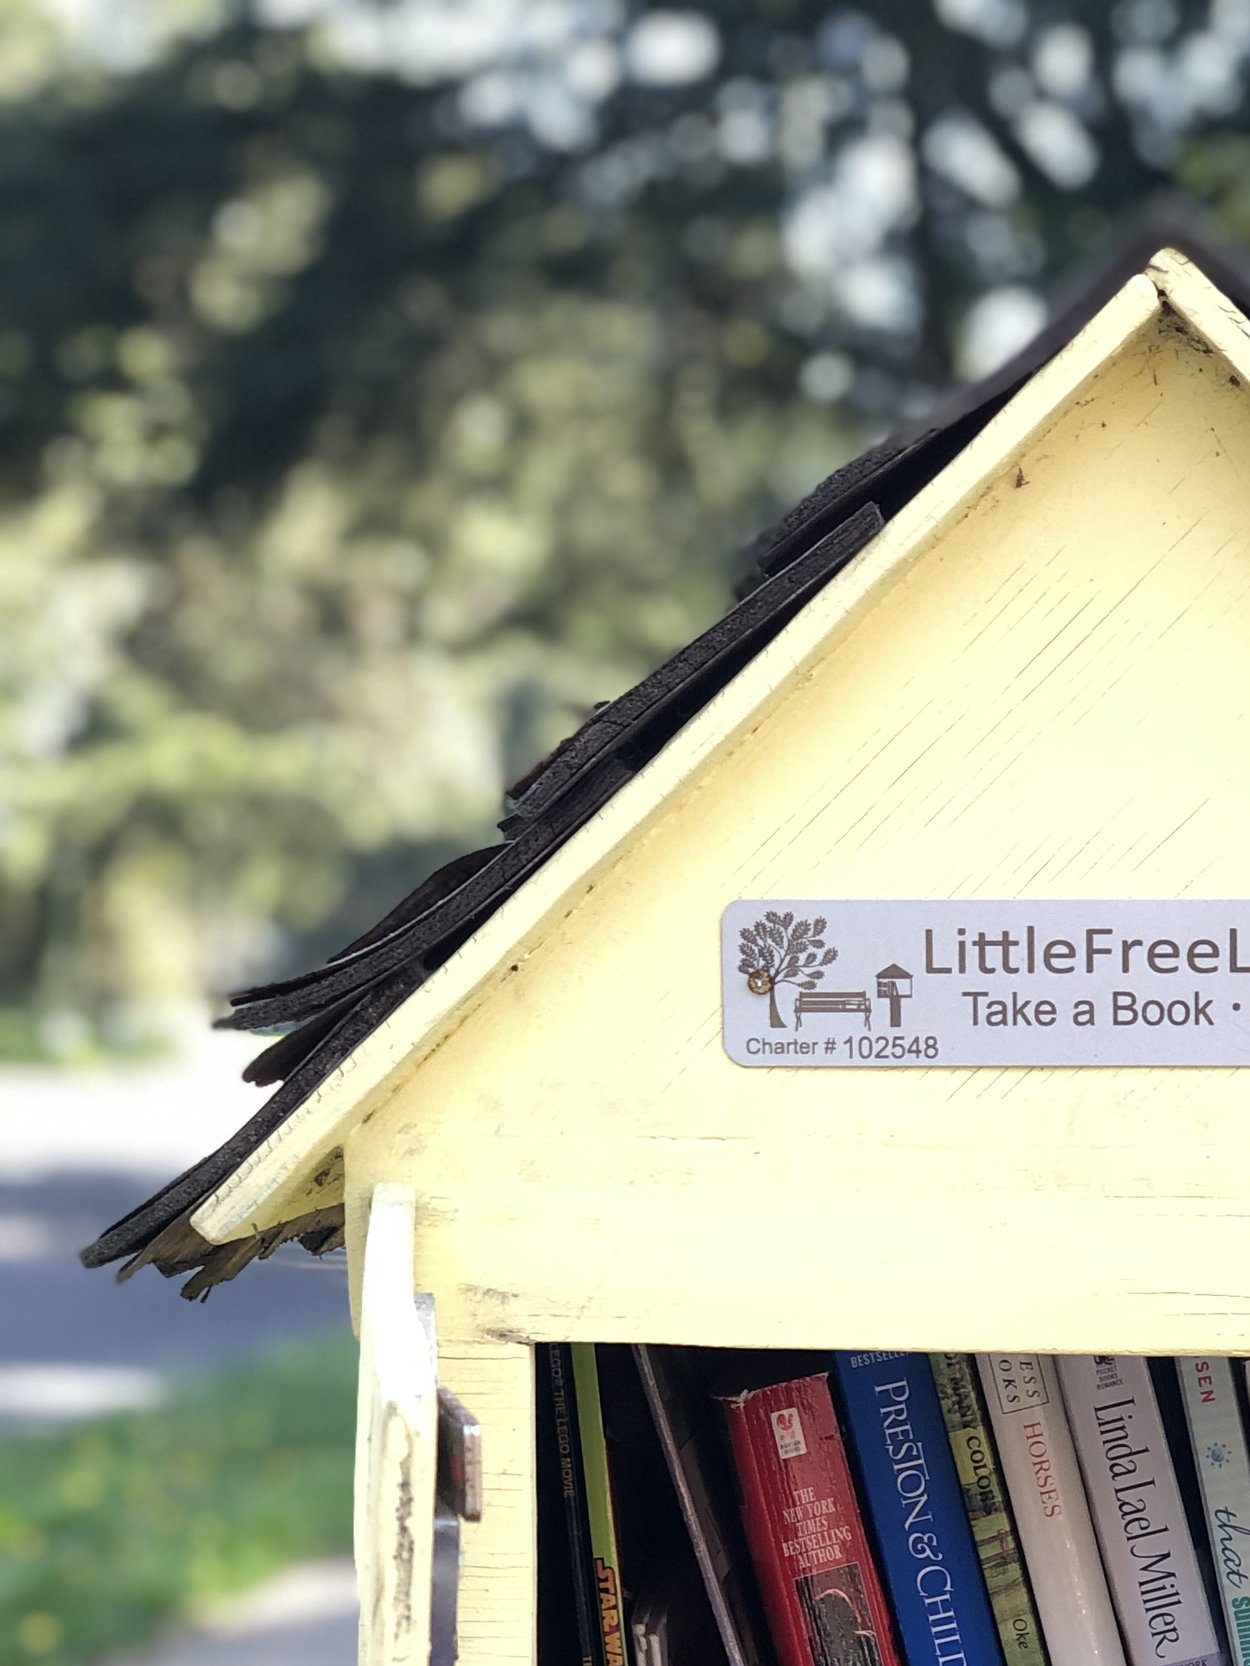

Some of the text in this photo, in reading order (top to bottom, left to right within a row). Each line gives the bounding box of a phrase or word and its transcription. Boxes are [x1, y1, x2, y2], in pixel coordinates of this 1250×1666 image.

[961, 990, 1058, 1027] Take
[1072, 1001, 1096, 1027] a
[1112, 990, 1215, 1027] Book
[745, 1035, 940, 1060] Charter 102548
[874, 1377, 933, 1531] PRESTON
[908, 1532, 943, 1560] &
[1022, 1422, 1062, 1518] HORSES
[1094, 1397, 1170, 1542] Linda Lael
[793, 1486, 816, 1506] THE
[805, 1497, 836, 1519] YORK
[782, 1525, 853, 1557] BESTSELLING
[796, 1516, 829, 1537] TIMES
[797, 1543, 843, 1569] AUTHOR
[594, 1557, 622, 1634] STAR
[1012, 1618, 1028, 1649] Oke
